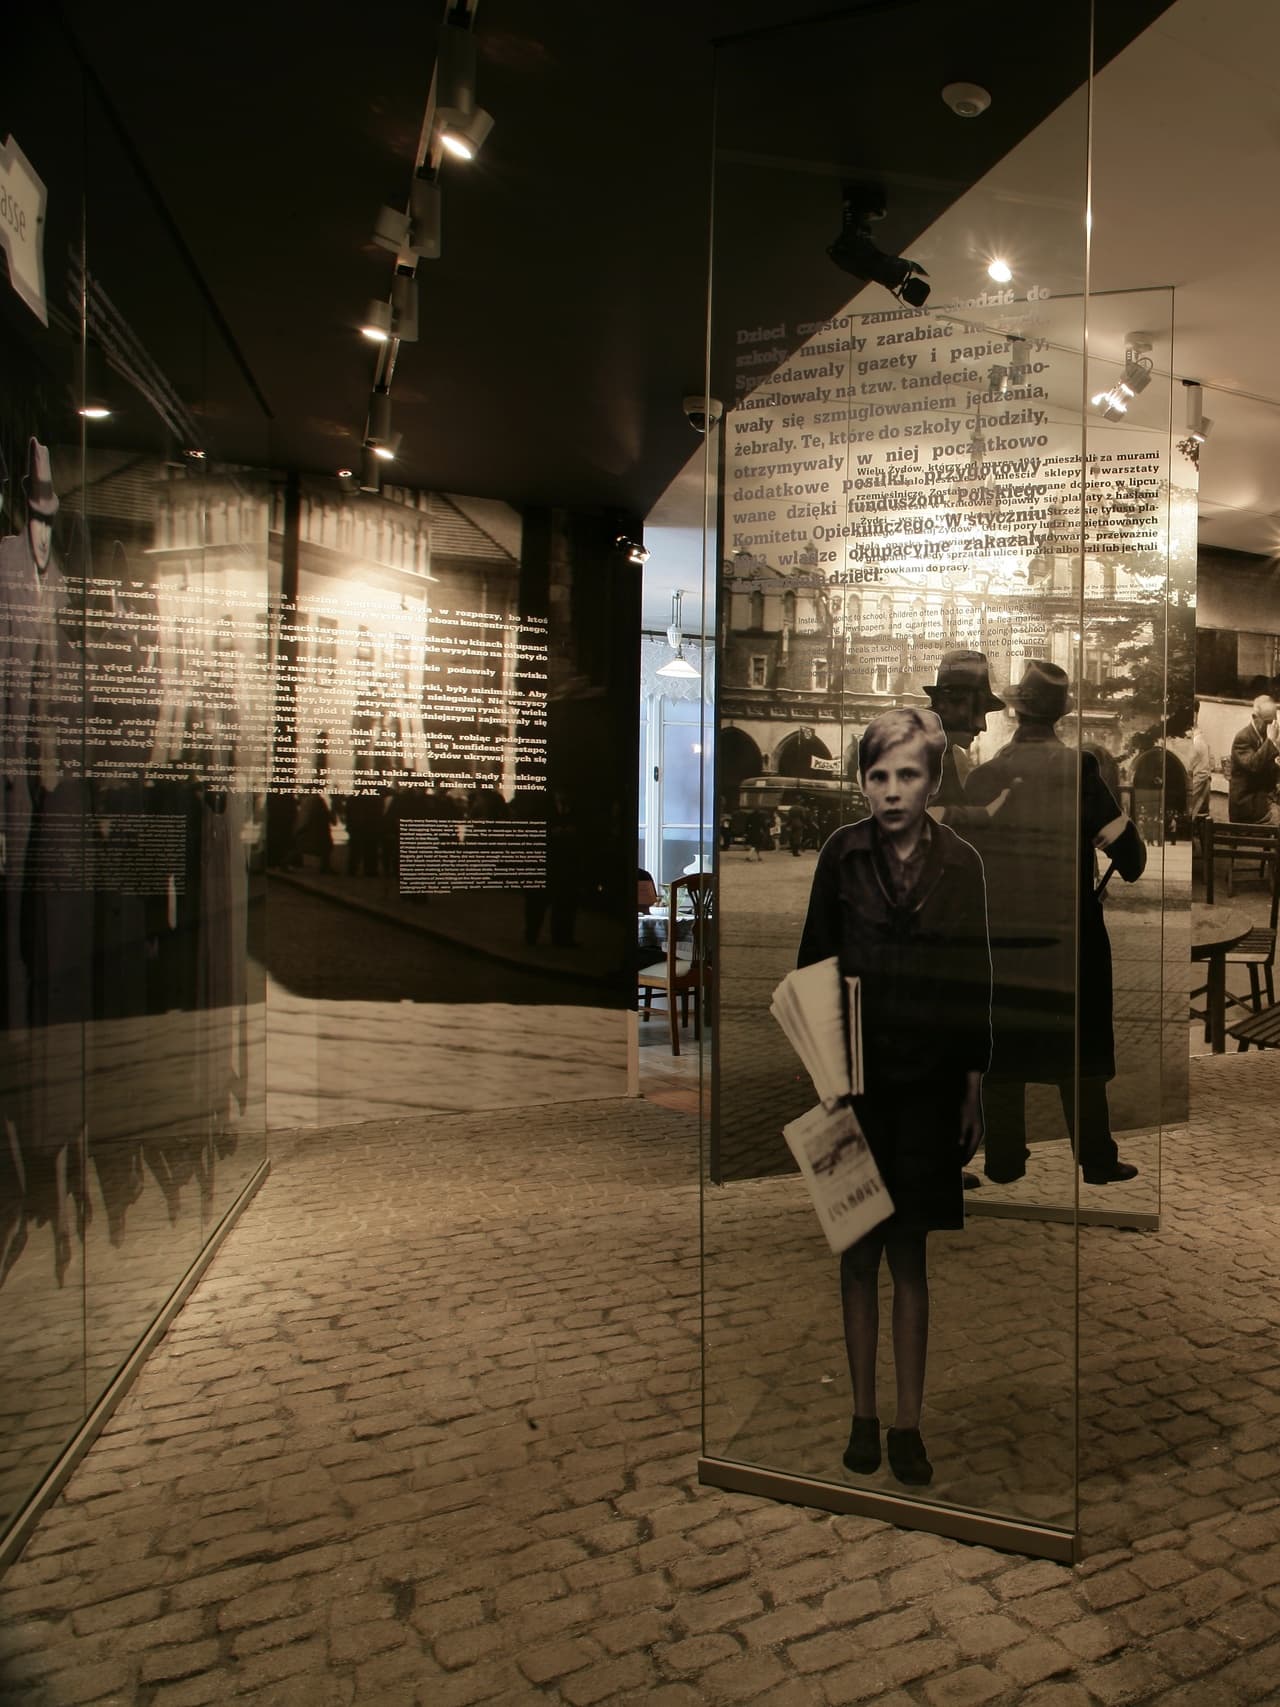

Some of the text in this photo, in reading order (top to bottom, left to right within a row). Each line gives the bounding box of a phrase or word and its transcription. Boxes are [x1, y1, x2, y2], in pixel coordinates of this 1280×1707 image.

[736, 323, 786, 345] Dzieci
[861, 303, 930, 325] zamiast
[1026, 285, 1051, 302] do
[876, 322, 953, 347] zarabiać
[857, 353, 918, 376] gazety
[950, 337, 1050, 364] papiersy,
[836, 385, 857, 398] na
[861, 381, 897, 395] tzw.
[902, 367, 983, 391] tandecie,
[782, 412, 805, 430] się
[966, 383, 1049, 410] jedzenia,
[801, 434, 826, 450] Te,
[829, 430, 875, 447] które
[879, 425, 900, 440] do
[857, 453, 873, 466] w
[886, 444, 919, 464] niej
[932, 434, 1048, 461] początkowo
[1116, 450, 1160, 461] murami
[1044, 464, 1160, 478] sklepy warsztaty
[734, 481, 830, 502] dodatkowe
[1129, 477, 1160, 488] lipcu.
[733, 509, 777, 524] wane
[786, 500, 838, 520] dzięki
[1014, 522, 1037, 532] pory
[733, 529, 808, 548] Komitetu
[993, 547, 1019, 557] ulice
[1102, 543, 1120, 553] lub
[1121, 541, 1159, 554] jechali
[939, 564, 970, 574] pracy.
[469, 638, 503, 649] kinach
[528, 690, 548, 700] Aby
